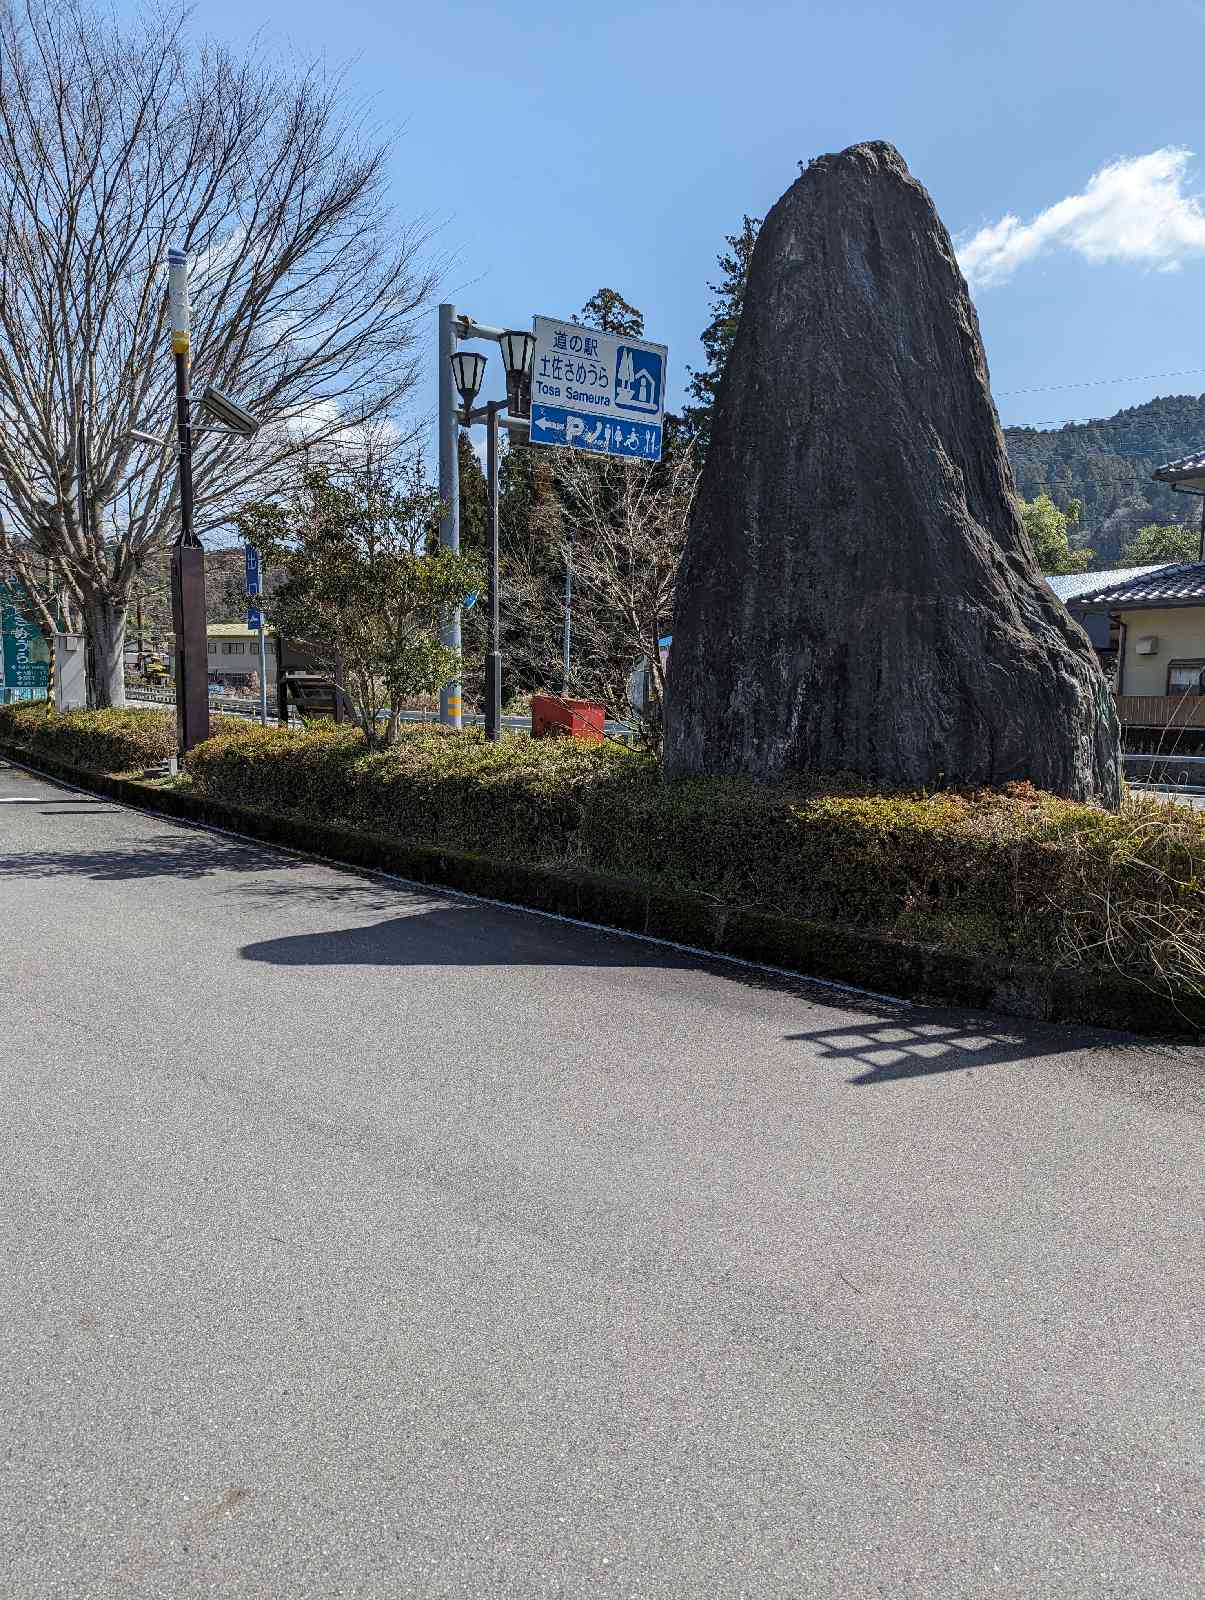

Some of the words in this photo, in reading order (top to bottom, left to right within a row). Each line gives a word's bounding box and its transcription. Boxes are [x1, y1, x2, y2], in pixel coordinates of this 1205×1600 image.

[552, 330, 598, 359] 道の駅
[539, 354, 609, 388] 土佐さめうら
[536, 381, 561, 397] Tosa
[566, 387, 610, 407] Sameura
